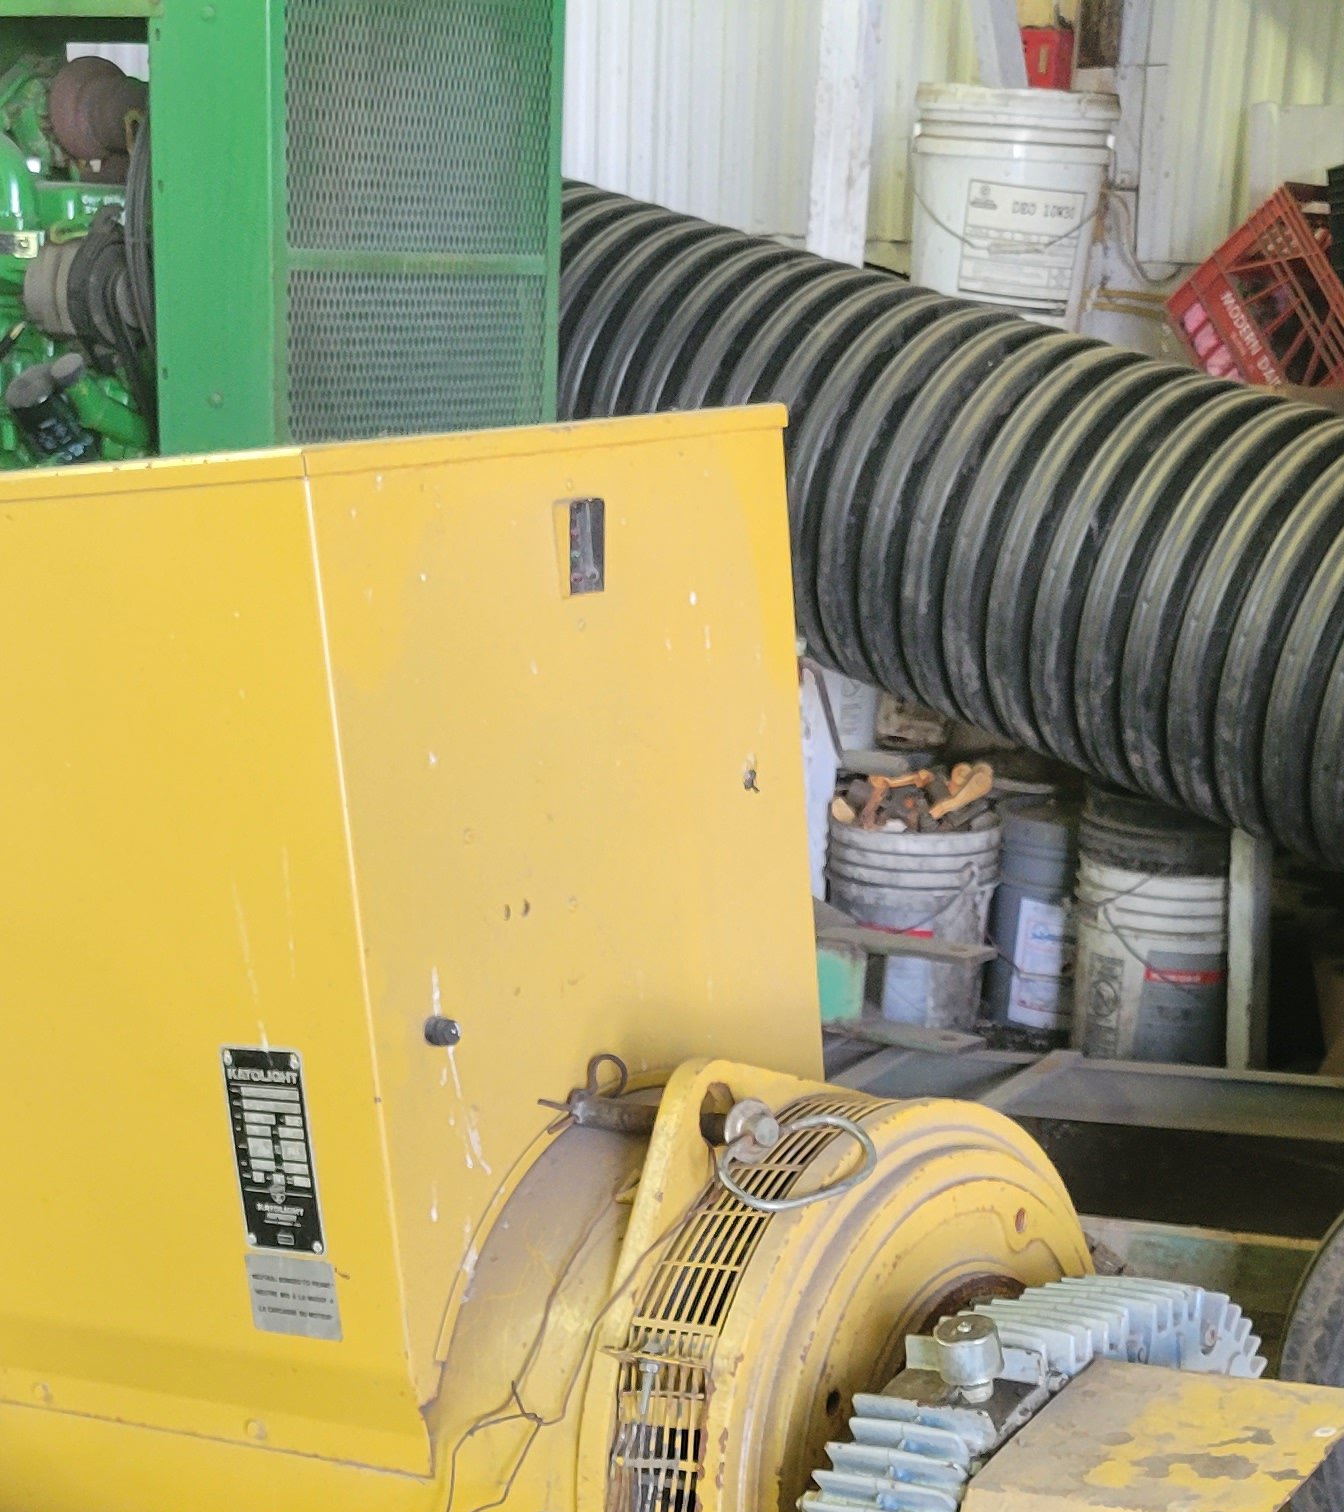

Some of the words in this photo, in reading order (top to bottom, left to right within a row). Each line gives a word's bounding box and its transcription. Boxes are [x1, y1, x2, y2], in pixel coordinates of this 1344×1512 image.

[1220, 290, 1264, 356] MODERN
[1257, 354, 1282, 385] DAI
[226, 1067, 298, 1085] KATOLIGHT
